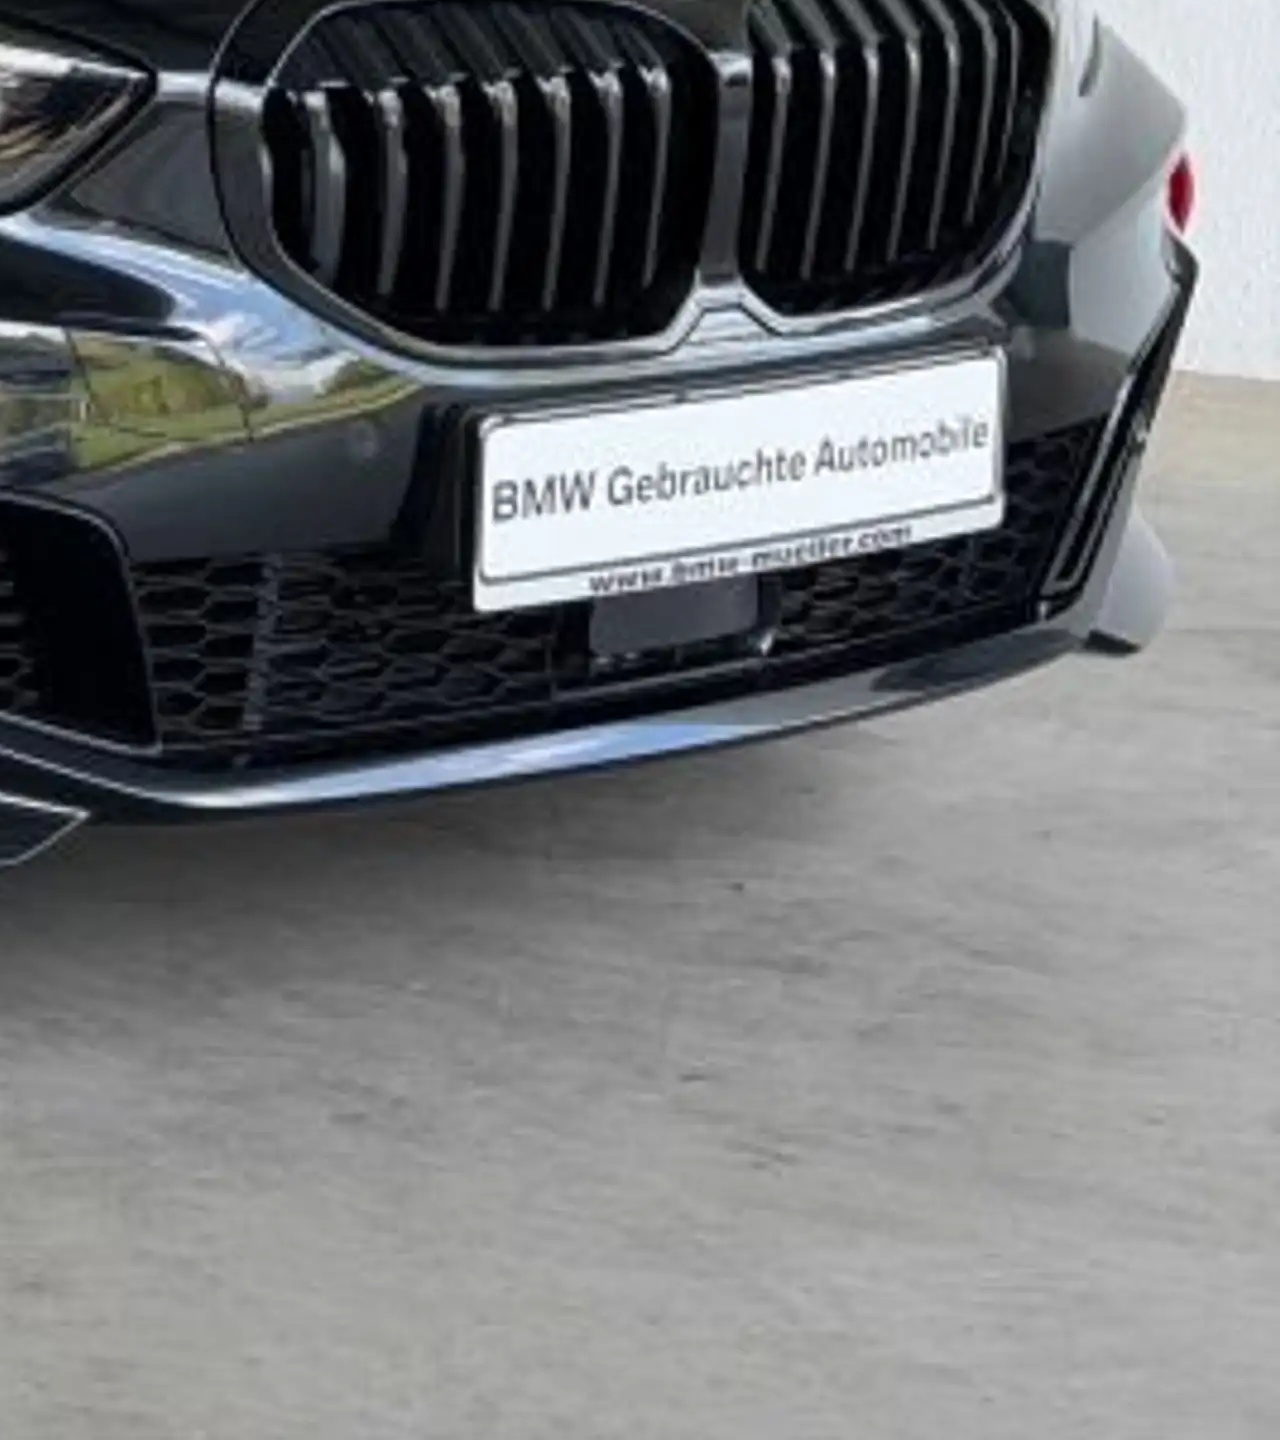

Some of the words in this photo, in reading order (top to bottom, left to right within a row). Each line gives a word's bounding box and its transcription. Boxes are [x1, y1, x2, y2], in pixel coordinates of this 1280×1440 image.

[492, 470, 596, 524] BMW
[608, 448, 806, 506] Gebrauchte
[814, 416, 989, 476] Automobile
